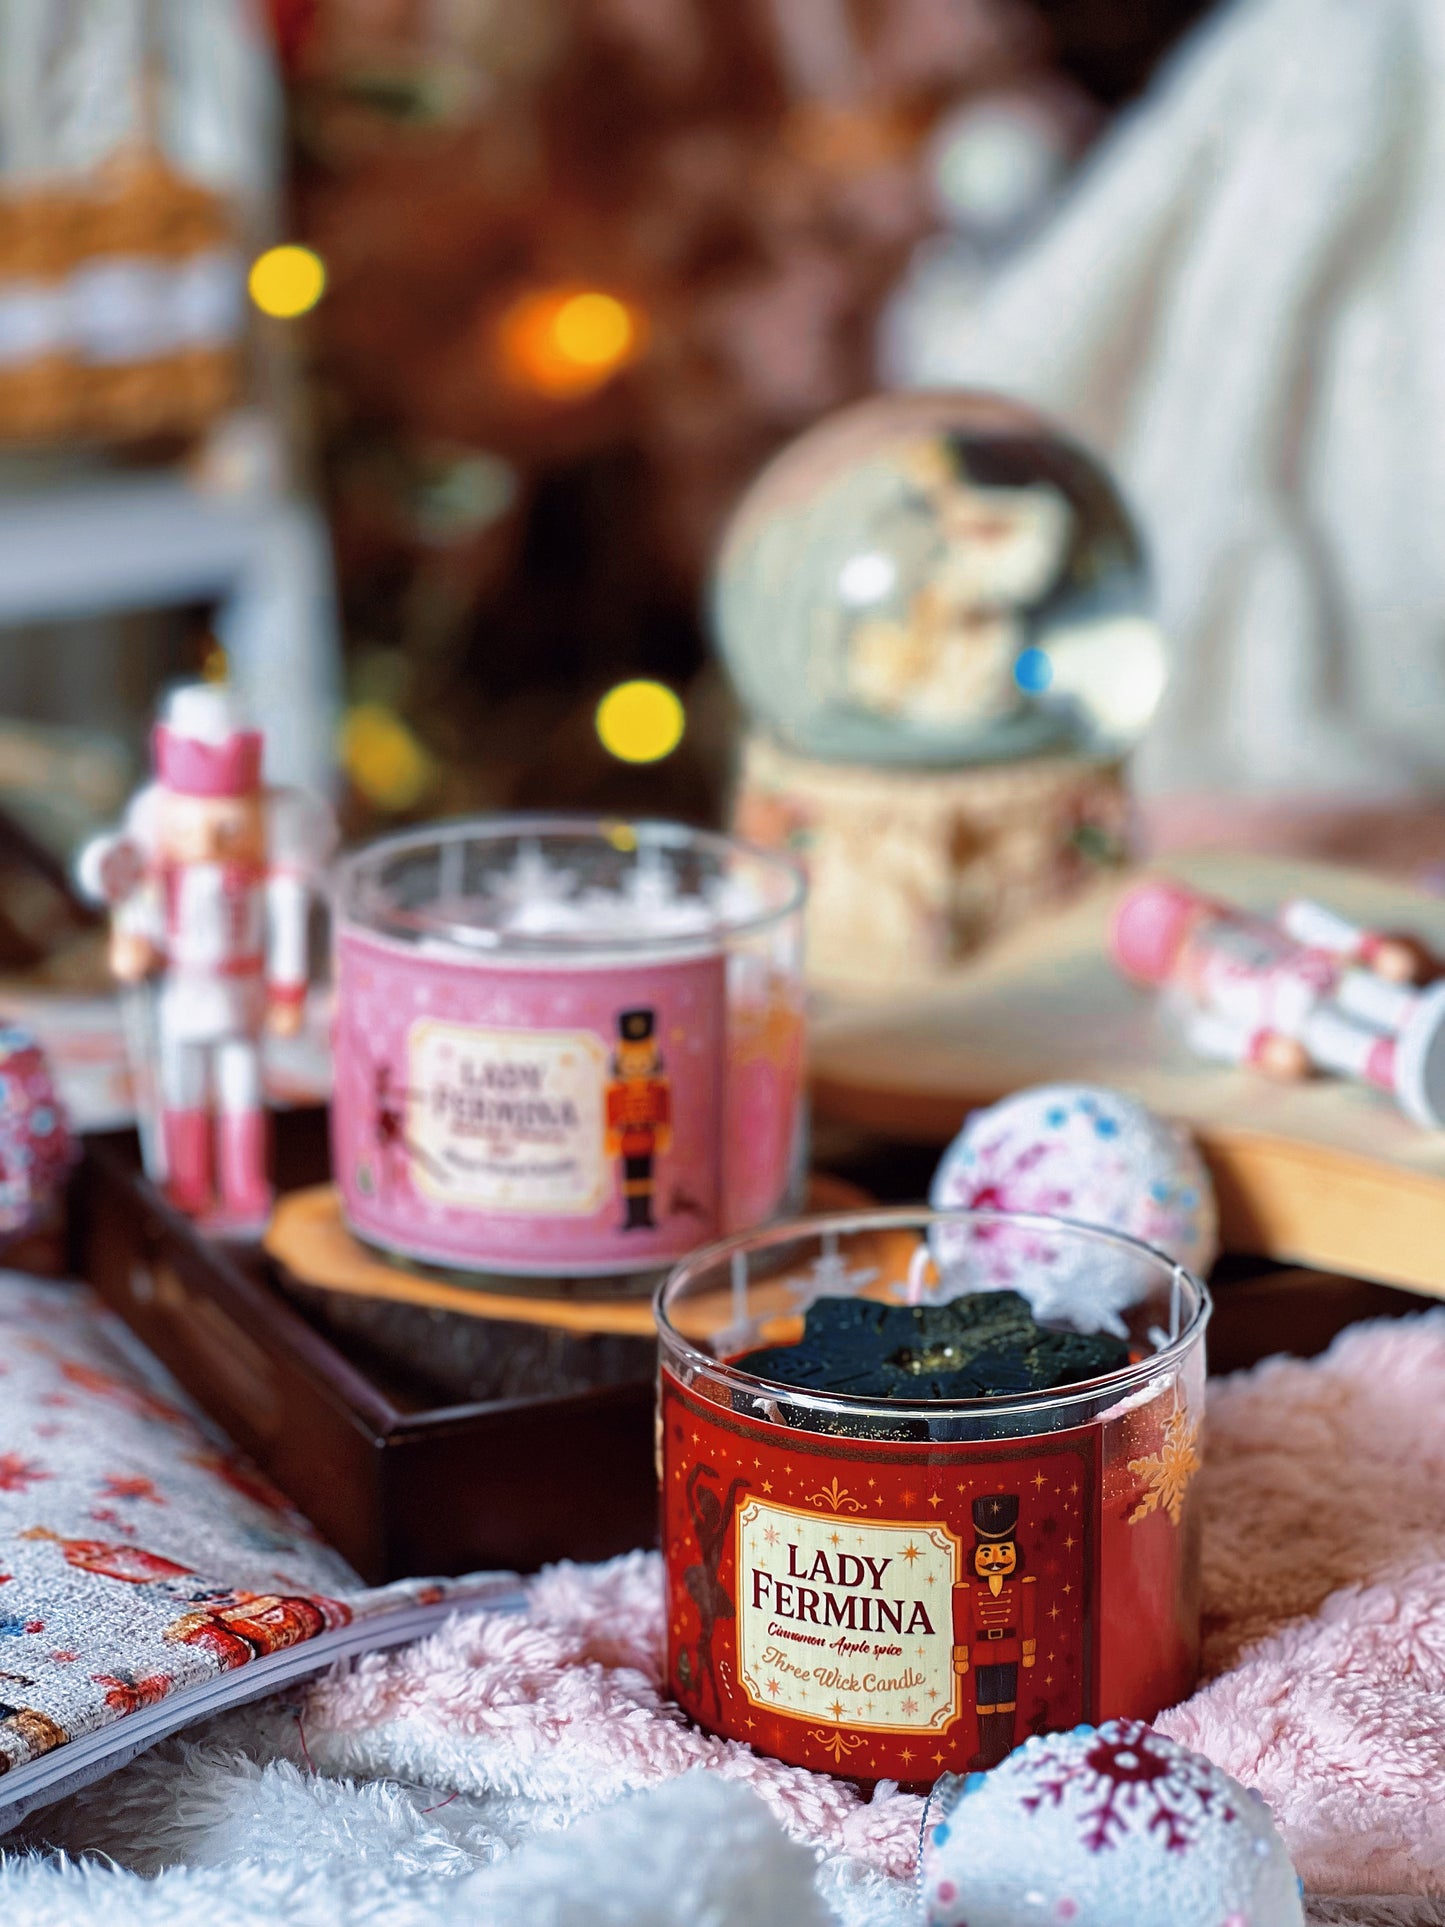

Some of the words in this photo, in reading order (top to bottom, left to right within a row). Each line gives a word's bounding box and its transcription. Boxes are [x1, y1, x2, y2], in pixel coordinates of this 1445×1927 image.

[787, 1543, 893, 1591] LADY
[751, 1568, 936, 1635] FERMINA
[767, 1621, 826, 1647] Cinnamon
[829, 1636, 870, 1659] Apple
[872, 1645, 903, 1660] spice
[761, 1646, 811, 1682] Three
[813, 1667, 862, 1692] Wick
[862, 1667, 926, 1693] Candle
